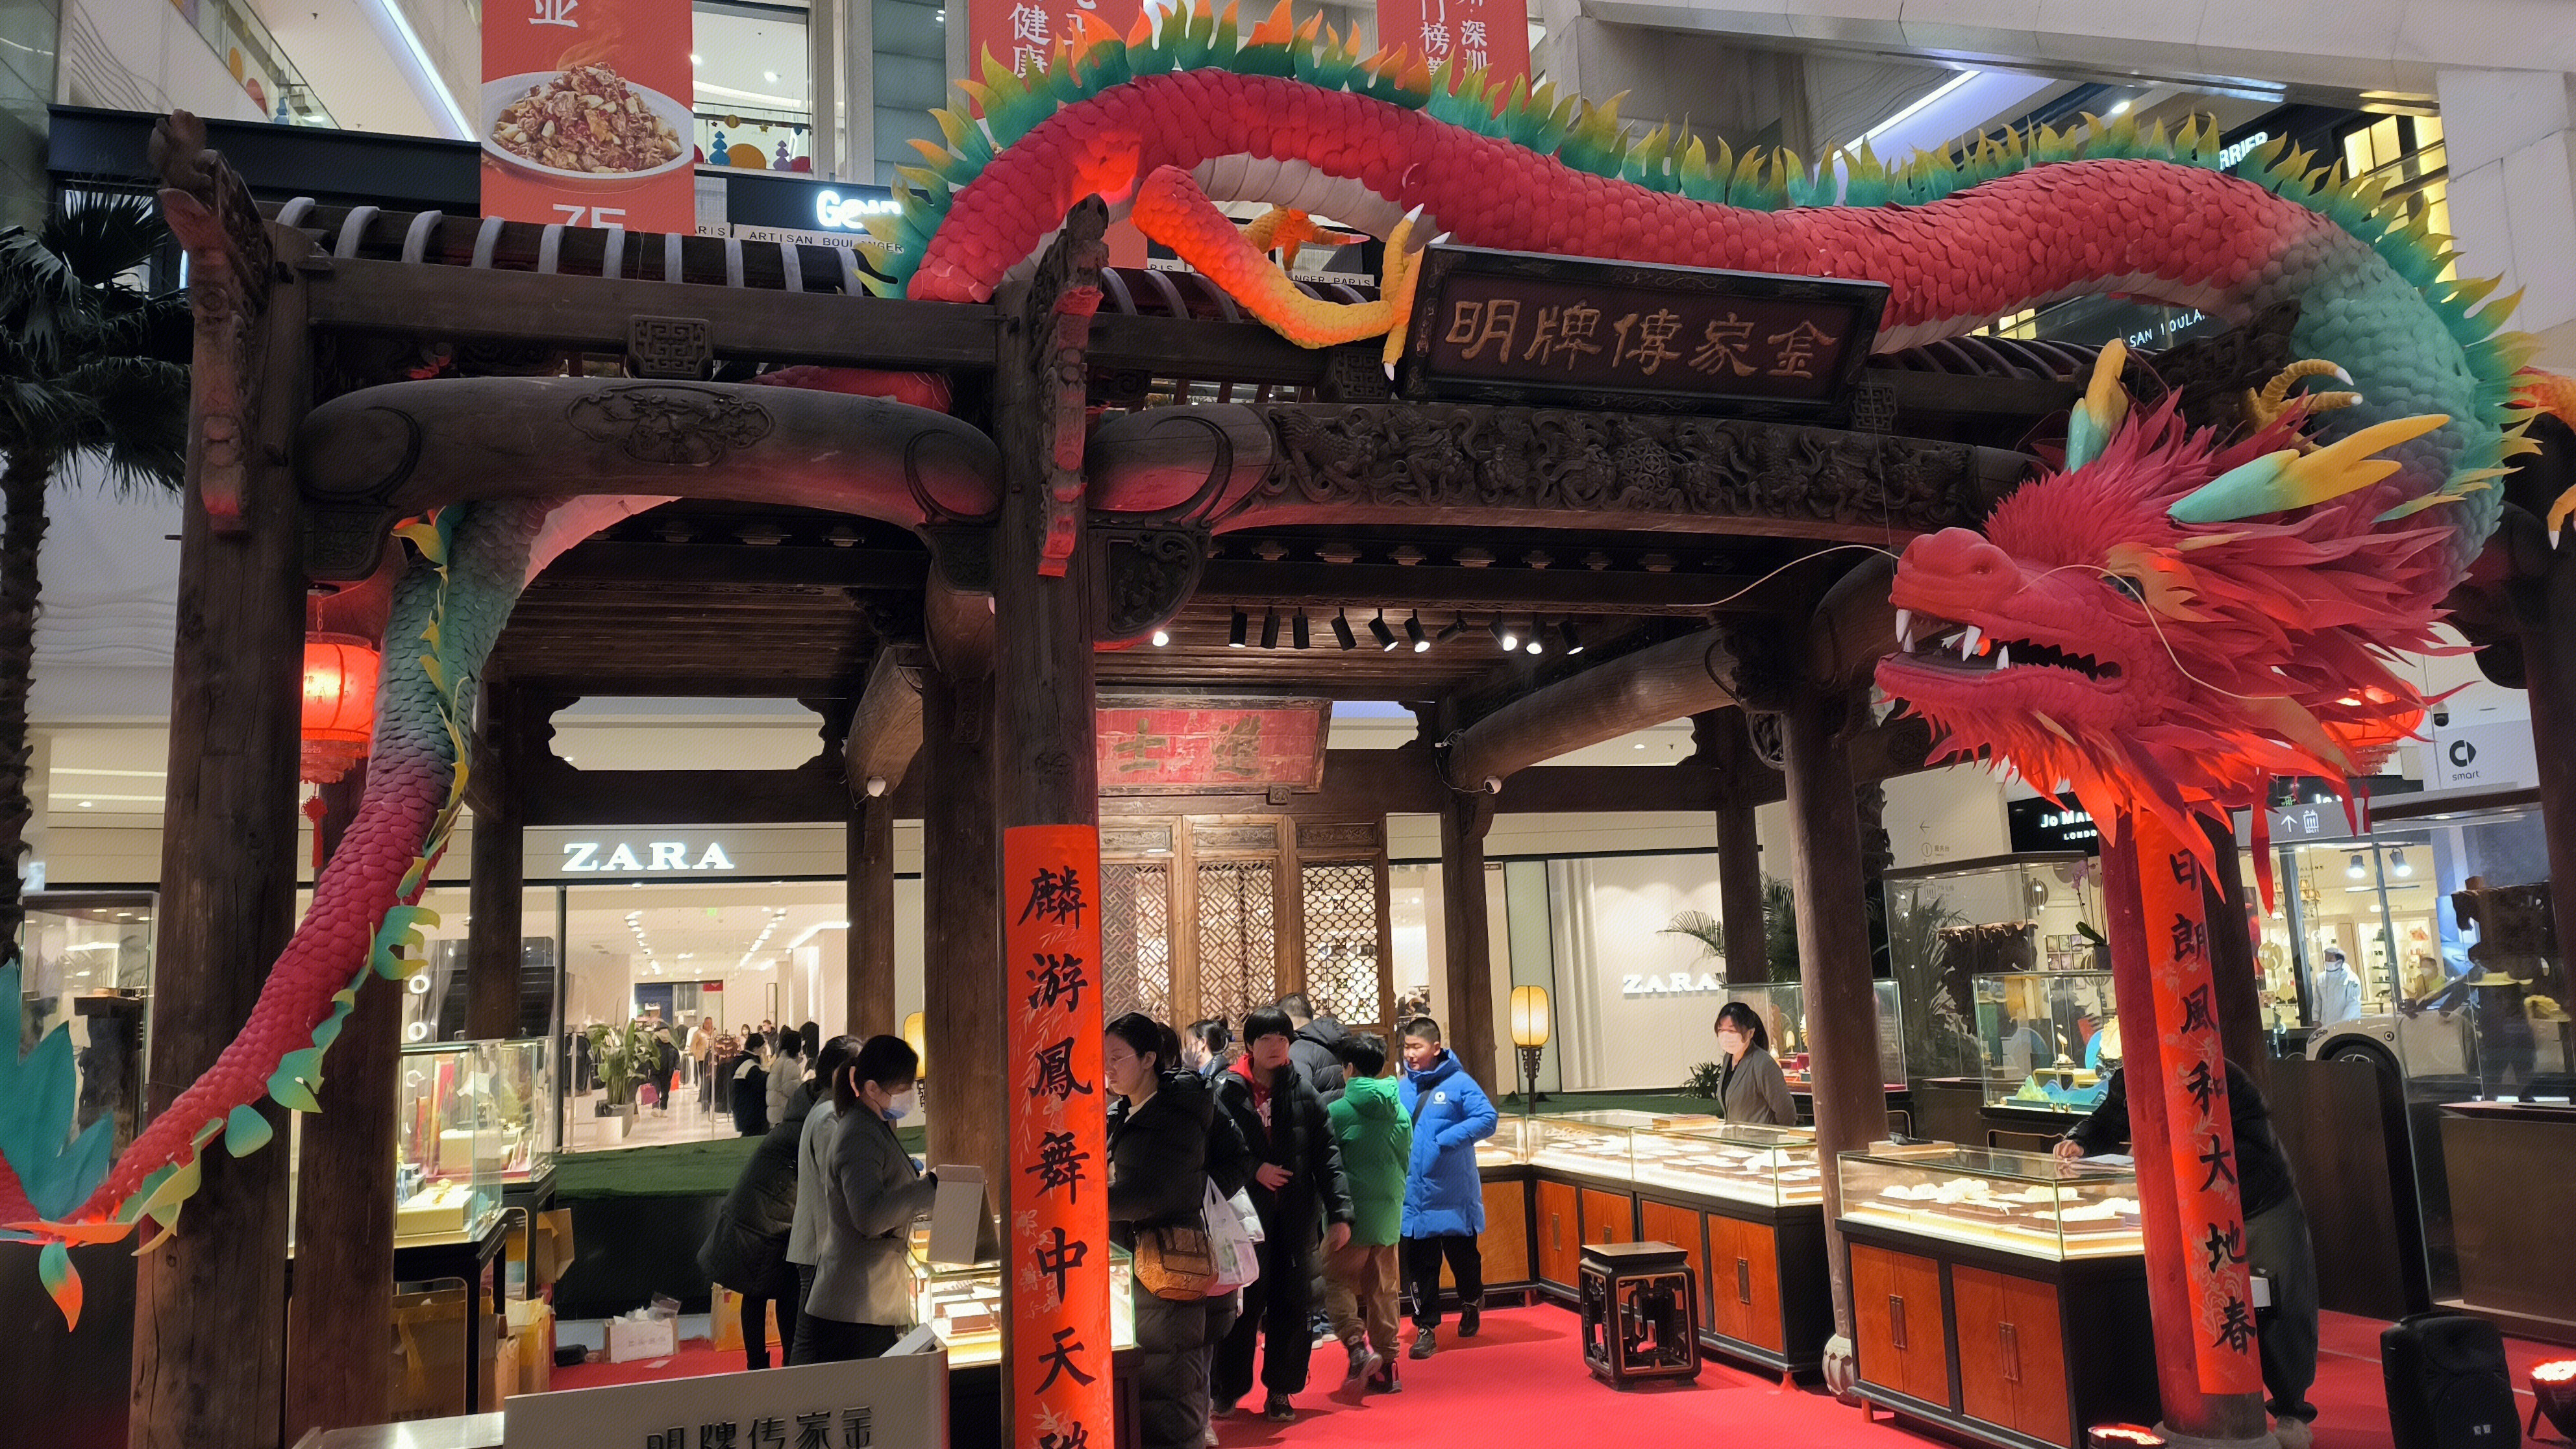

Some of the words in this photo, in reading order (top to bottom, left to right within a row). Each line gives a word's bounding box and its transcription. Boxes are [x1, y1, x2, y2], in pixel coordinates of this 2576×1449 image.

[695, 225, 726, 236] RIS
[749, 231, 813, 245] ARTISAN
[823, 237, 902, 252] BOULGER
[1444, 299, 1839, 380] 明牌傳家金
[2452, 770, 2481, 781] smart
[561, 841, 736, 872] ZARA
[1622, 972, 1720, 995] ZARA
